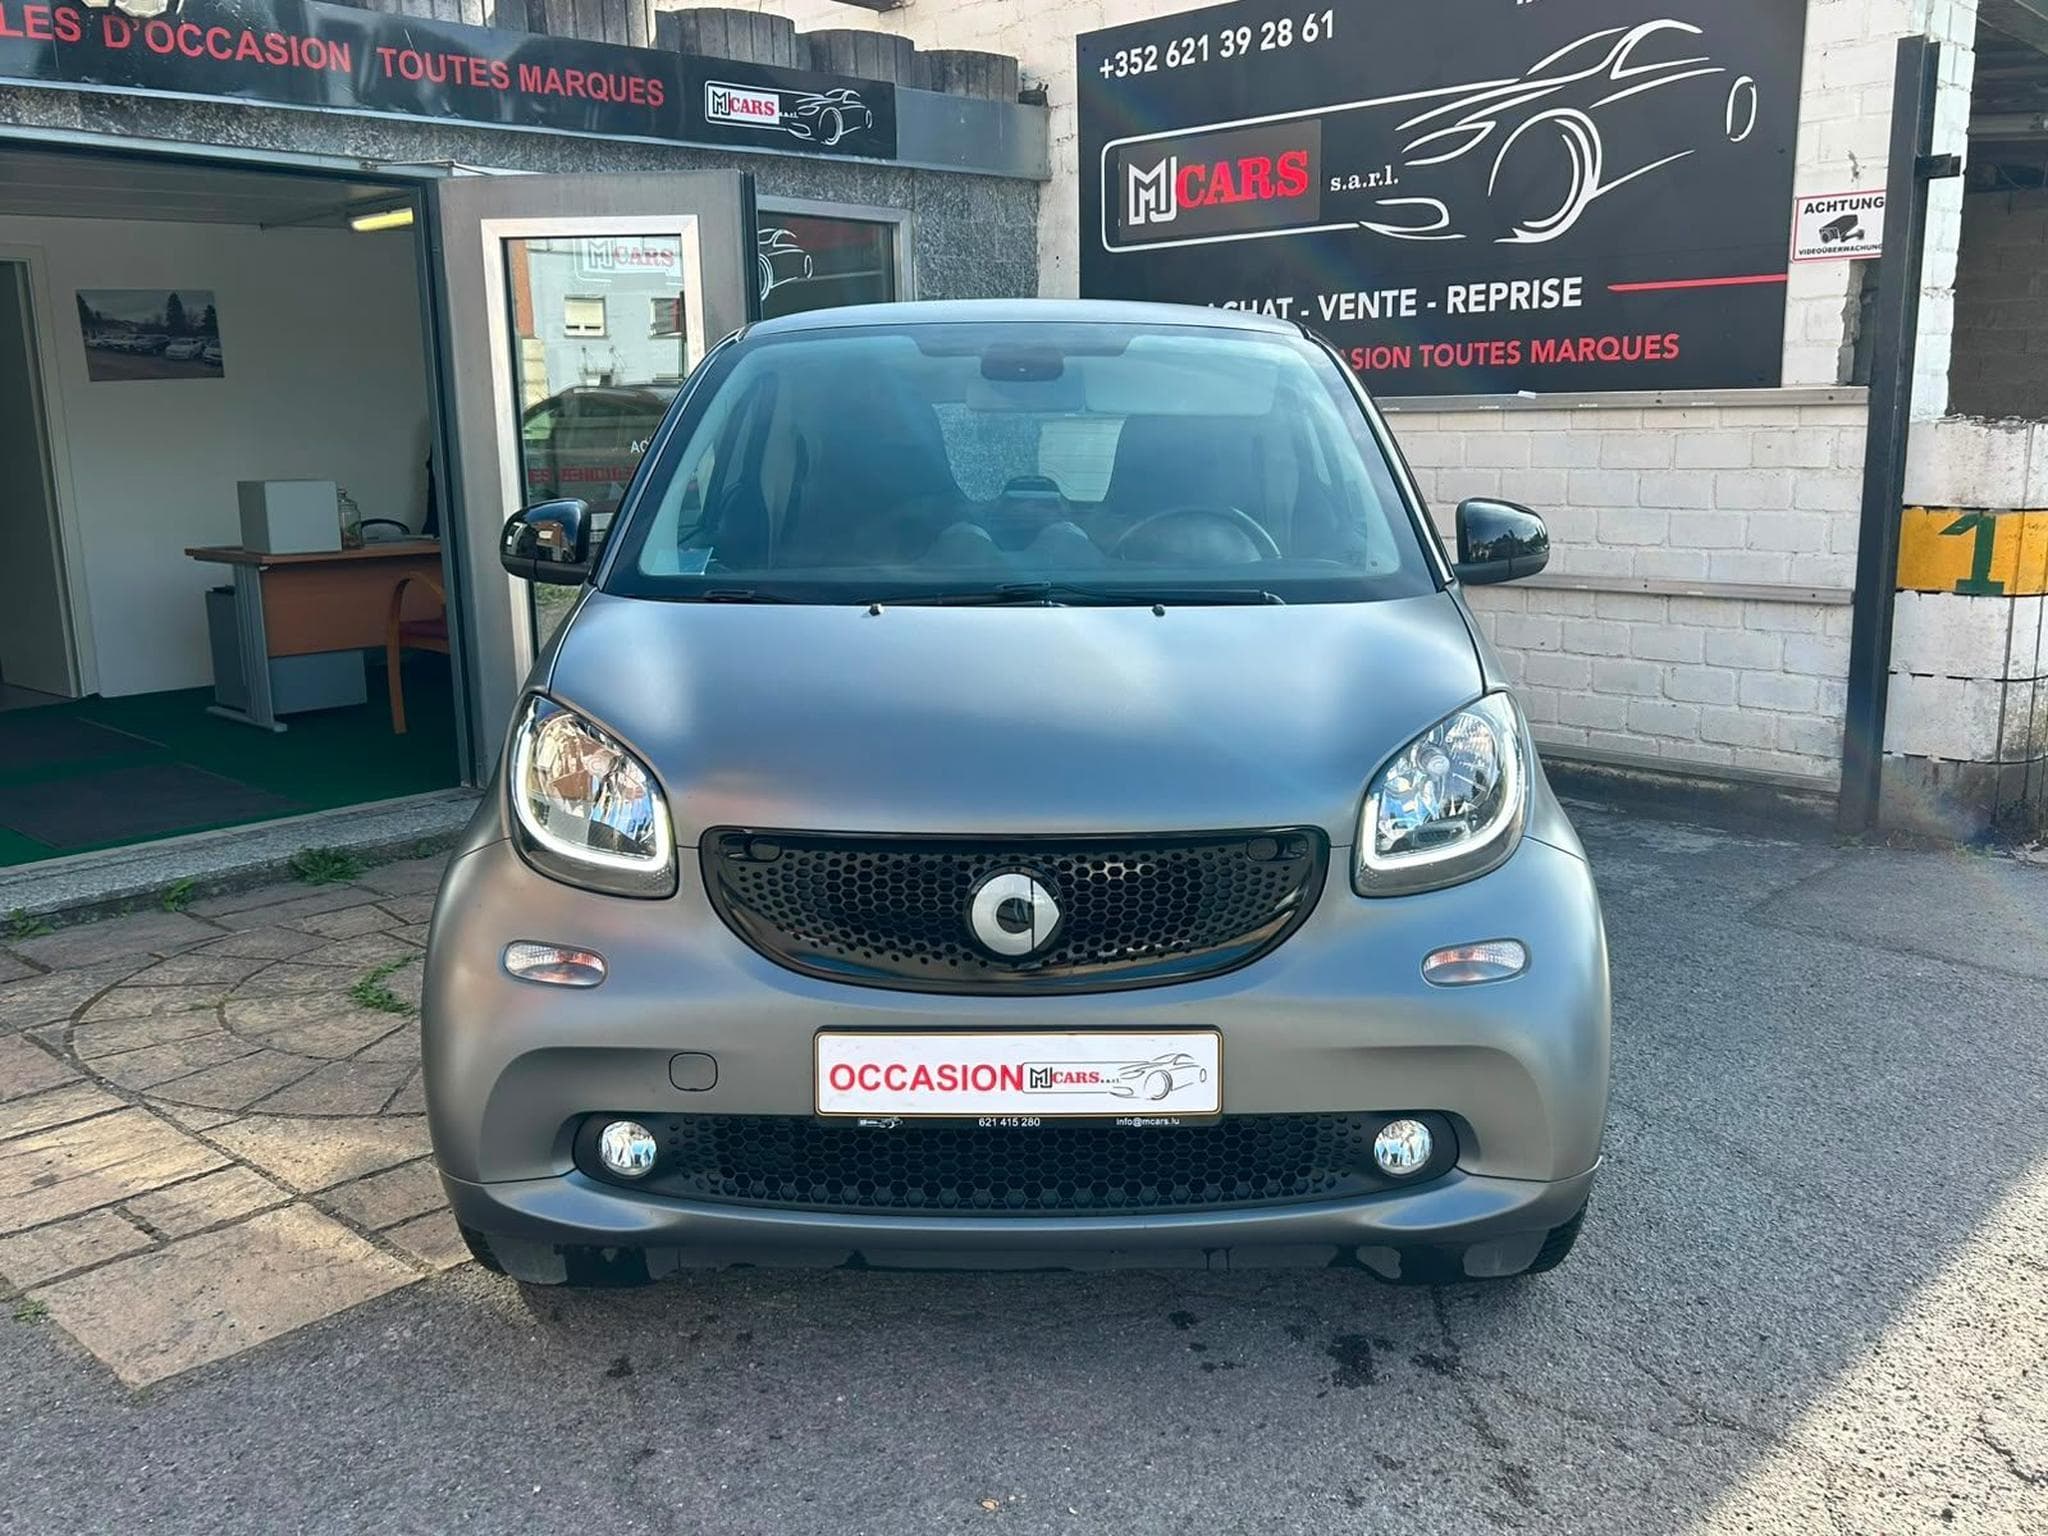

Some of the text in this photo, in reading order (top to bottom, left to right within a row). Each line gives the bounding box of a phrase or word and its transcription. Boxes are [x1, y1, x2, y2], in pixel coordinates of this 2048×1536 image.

[102, 15, 350, 73] D'OCCASION
[376, 47, 509, 90] TOUTES
[518, 64, 664, 106] MARQUES
[1100, 10, 1334, 79] +352 621 39 28 61
[1330, 164, 1399, 191] s.a.r.l.
[1804, 196, 1885, 214] ACHTUNG
[1317, 288, 1417, 321] VENTE
[1447, 277, 1583, 314] REPRISE
[1419, 340, 1520, 368] TOUTES
[1531, 333, 1680, 363] MARQUES
[1939, 514, 2004, 595] 1
[829, 1064, 1023, 1091] OCCASION
[978, 1117, 996, 1127] 621
[1000, 1117, 1018, 1127] 415
[1021, 1117, 1040, 1127] 280
